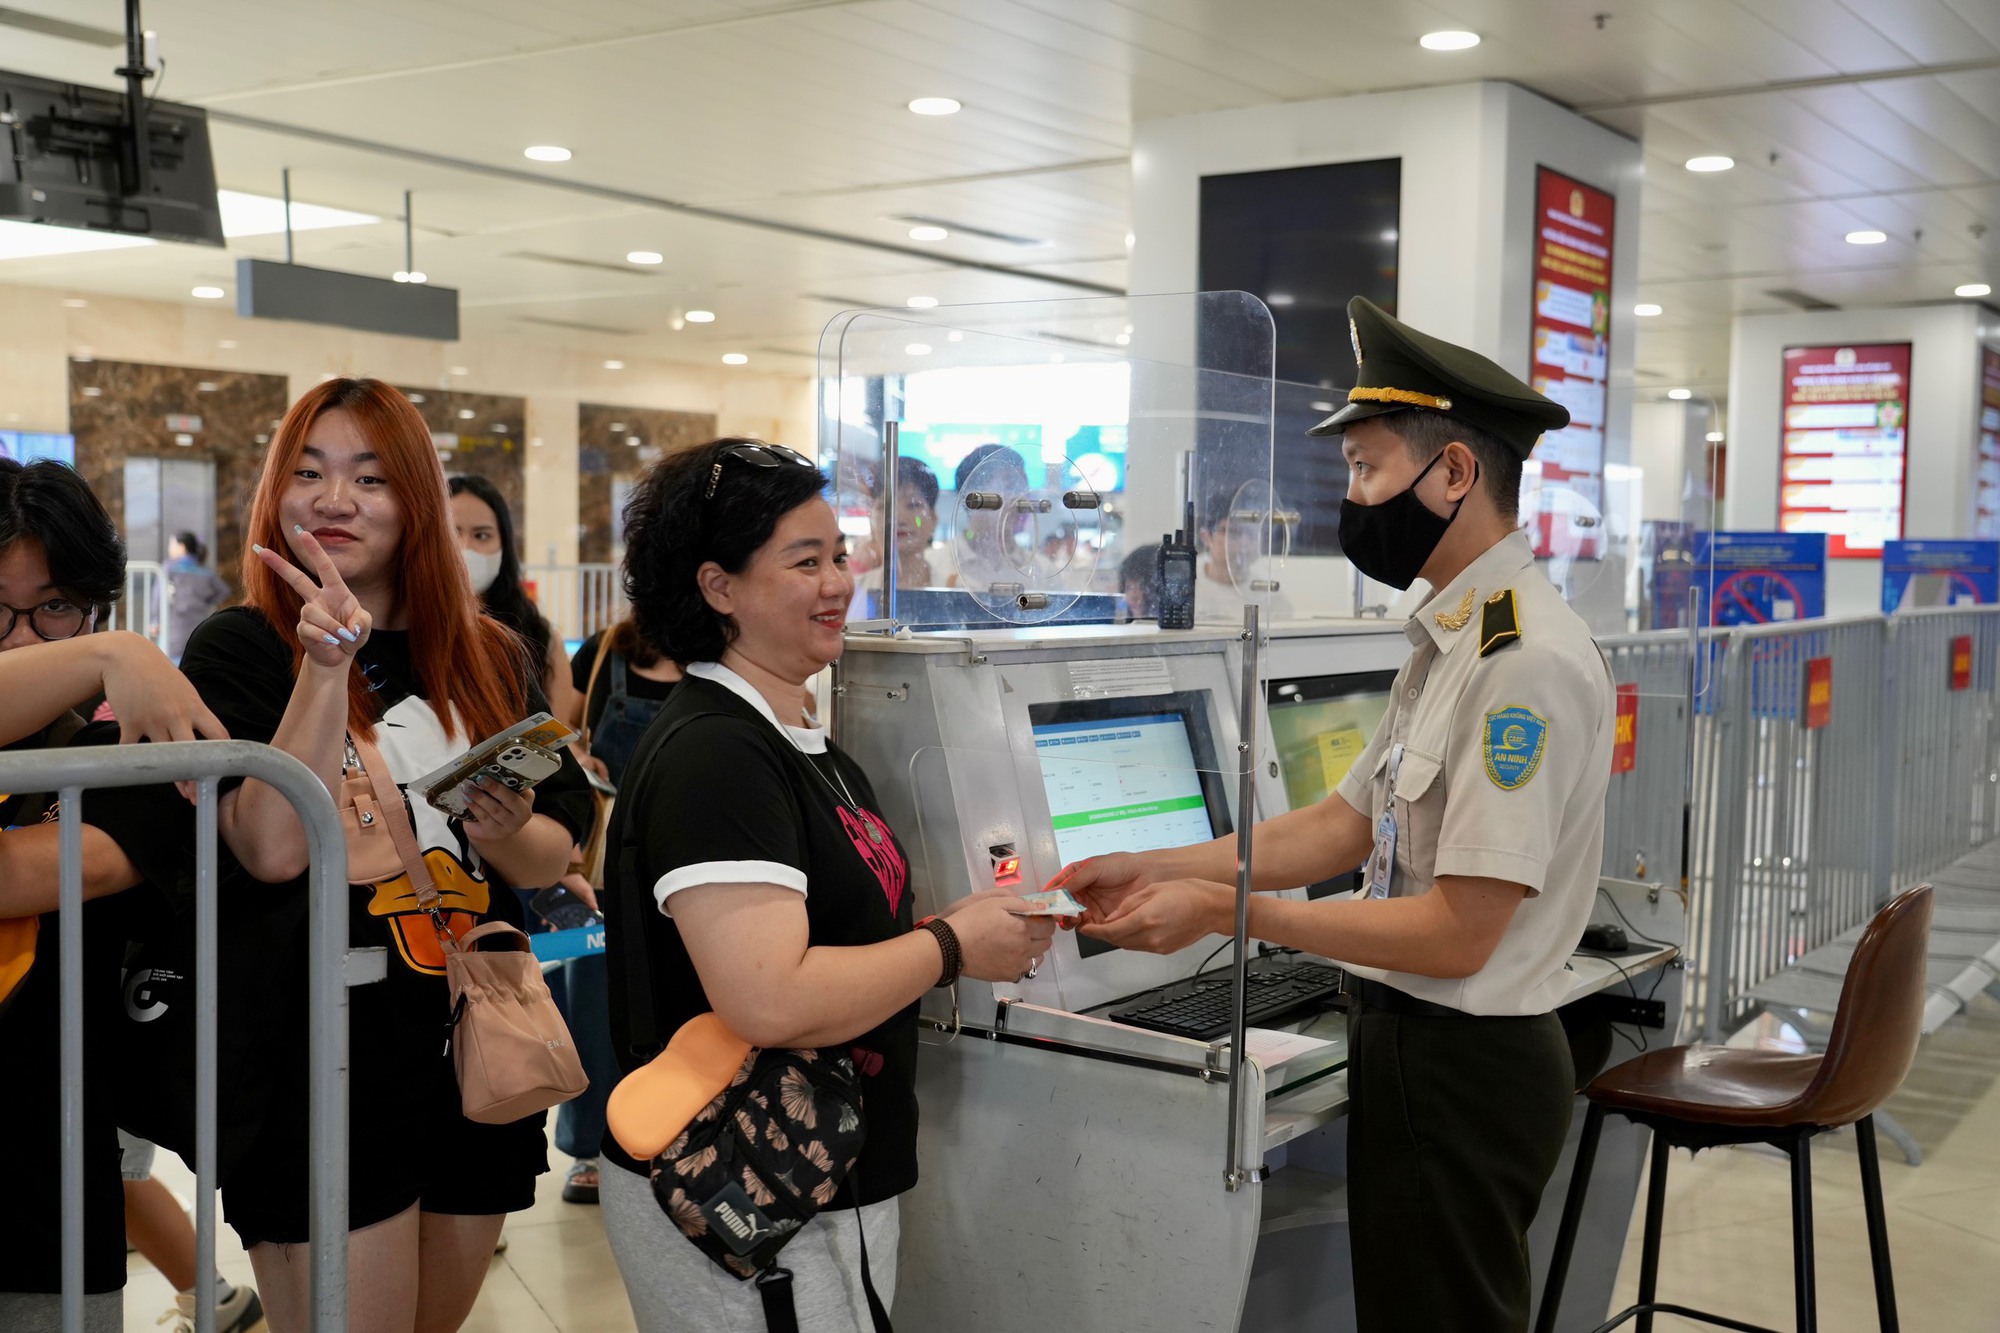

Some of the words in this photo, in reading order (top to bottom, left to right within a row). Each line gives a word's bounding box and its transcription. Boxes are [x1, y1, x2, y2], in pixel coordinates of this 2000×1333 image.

[1494, 753, 1507, 762] AN
[1507, 754, 1528, 764] NINH
[714, 1201, 751, 1239] PUMA
